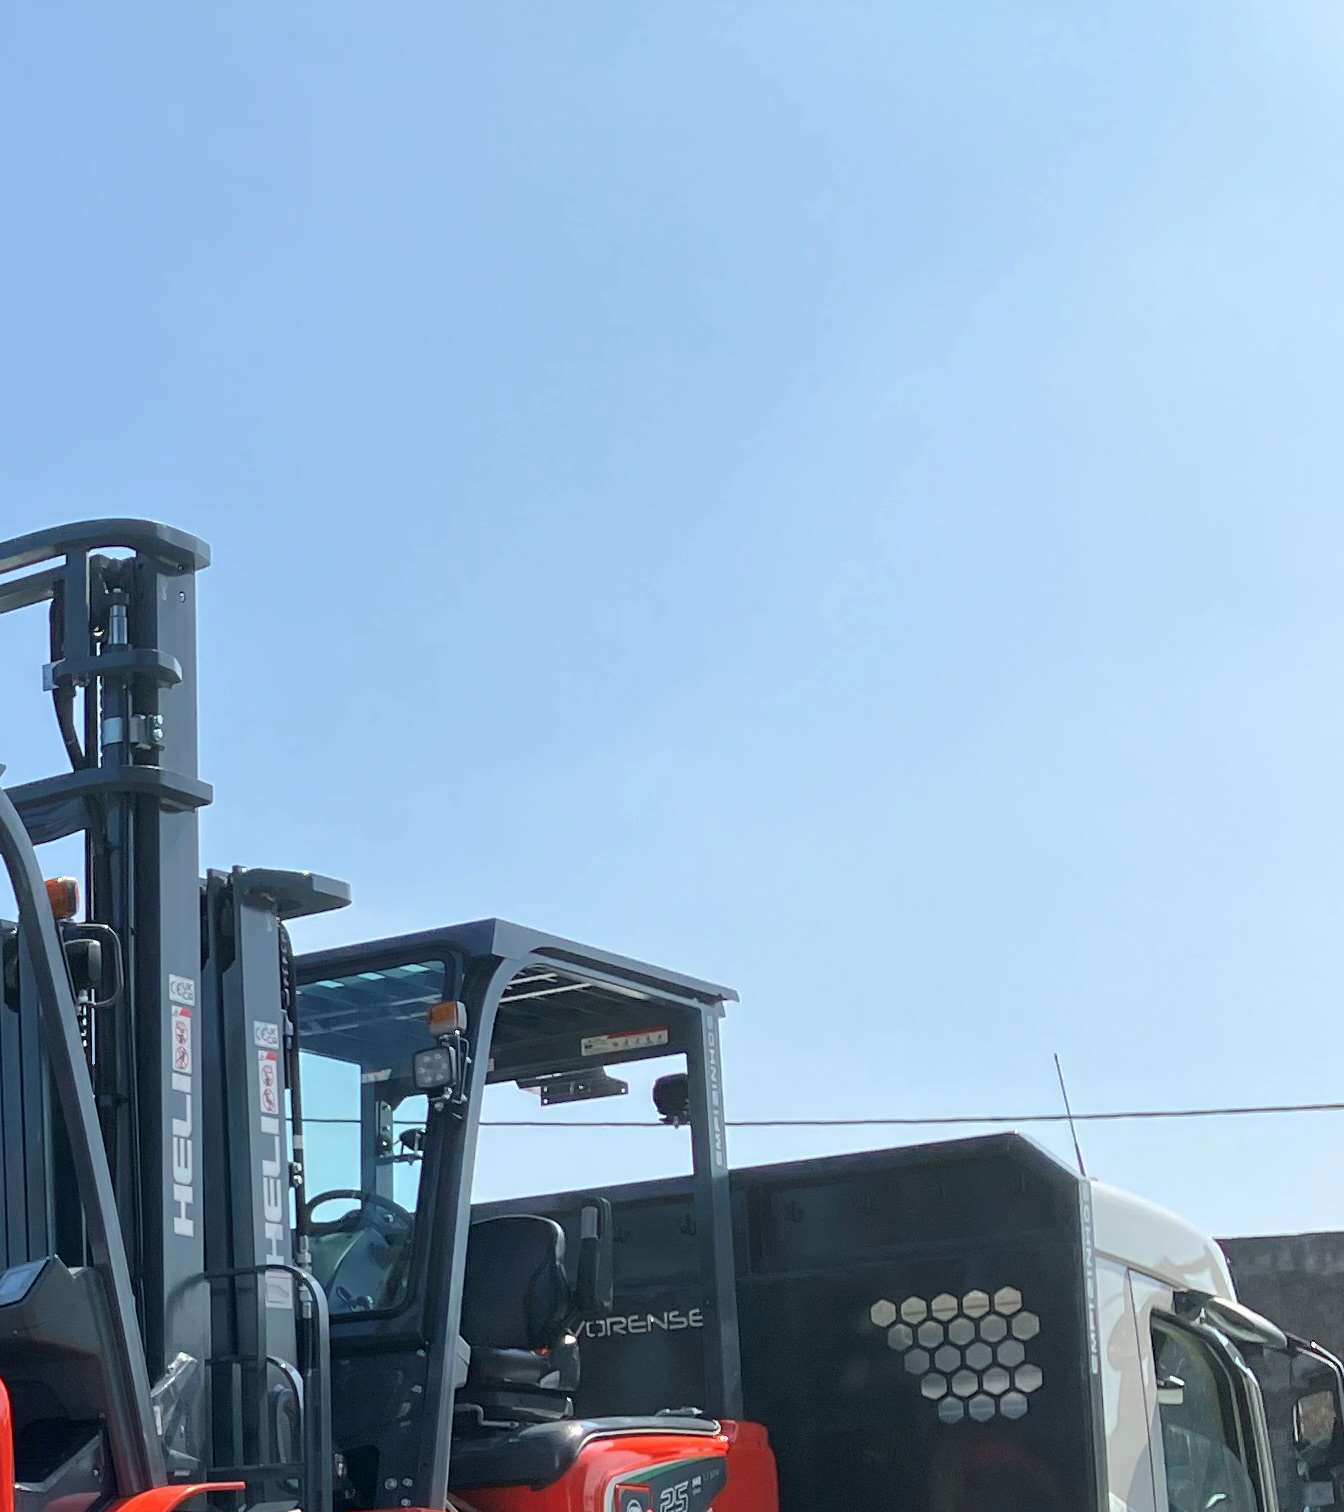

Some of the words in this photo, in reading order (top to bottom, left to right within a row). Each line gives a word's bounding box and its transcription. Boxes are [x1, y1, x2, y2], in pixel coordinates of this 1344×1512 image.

[171, 1072, 195, 1238] HELI
[261, 1115, 284, 1265] HELI
[566, 1308, 704, 1337] VORENSE
